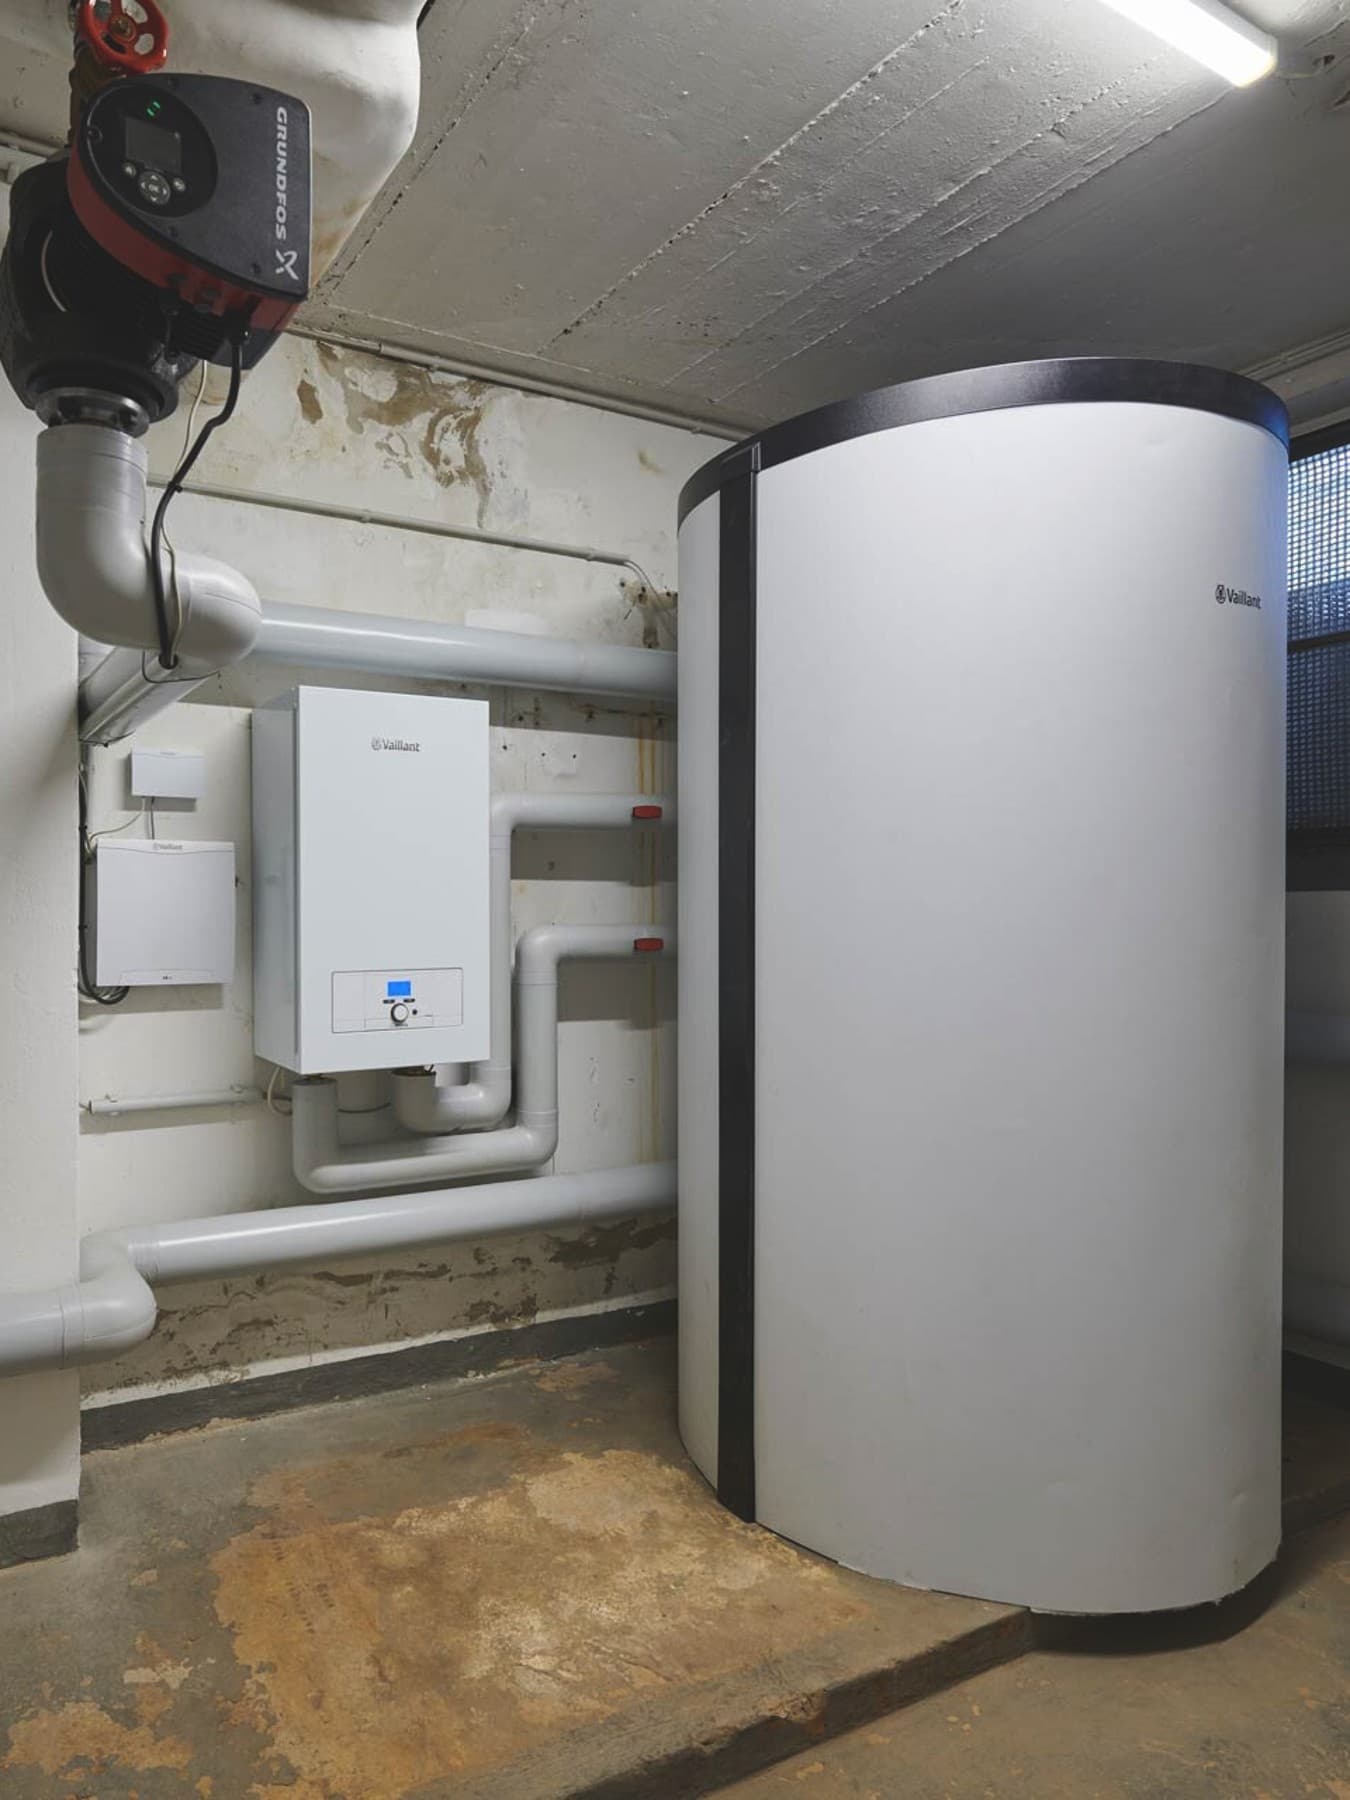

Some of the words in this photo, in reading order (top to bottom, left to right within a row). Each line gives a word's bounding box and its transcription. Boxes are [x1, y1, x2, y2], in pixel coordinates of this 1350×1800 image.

[275, 106, 288, 240] GRUNDFOS
[1226, 587, 1262, 610] Vaillant
[382, 738, 420, 752] Vaillant
